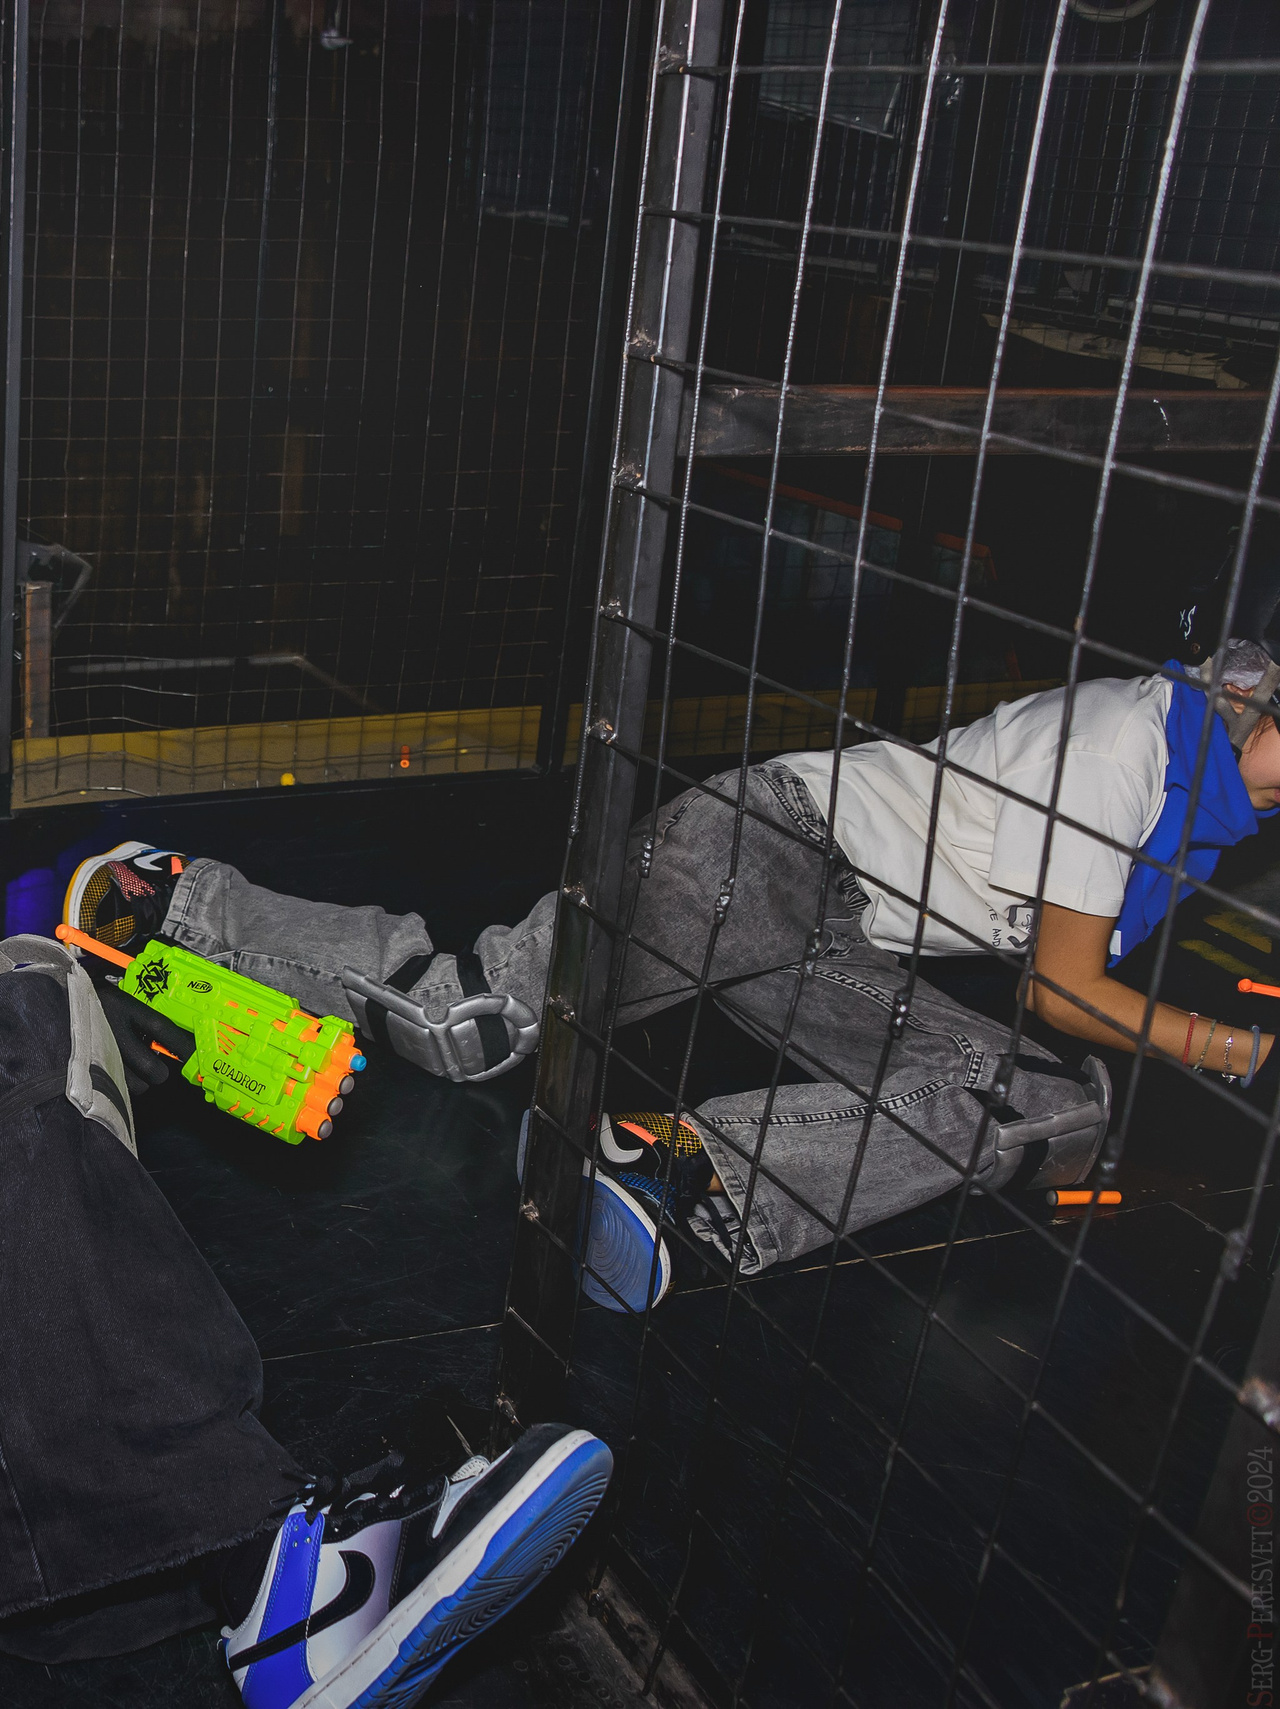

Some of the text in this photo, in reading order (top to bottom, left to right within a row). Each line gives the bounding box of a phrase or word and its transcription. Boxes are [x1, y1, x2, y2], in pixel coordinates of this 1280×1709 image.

[992, 928, 1002, 947] AND
[187, 980, 212, 993] NERF
[212, 1058, 266, 1096] QUADROT
